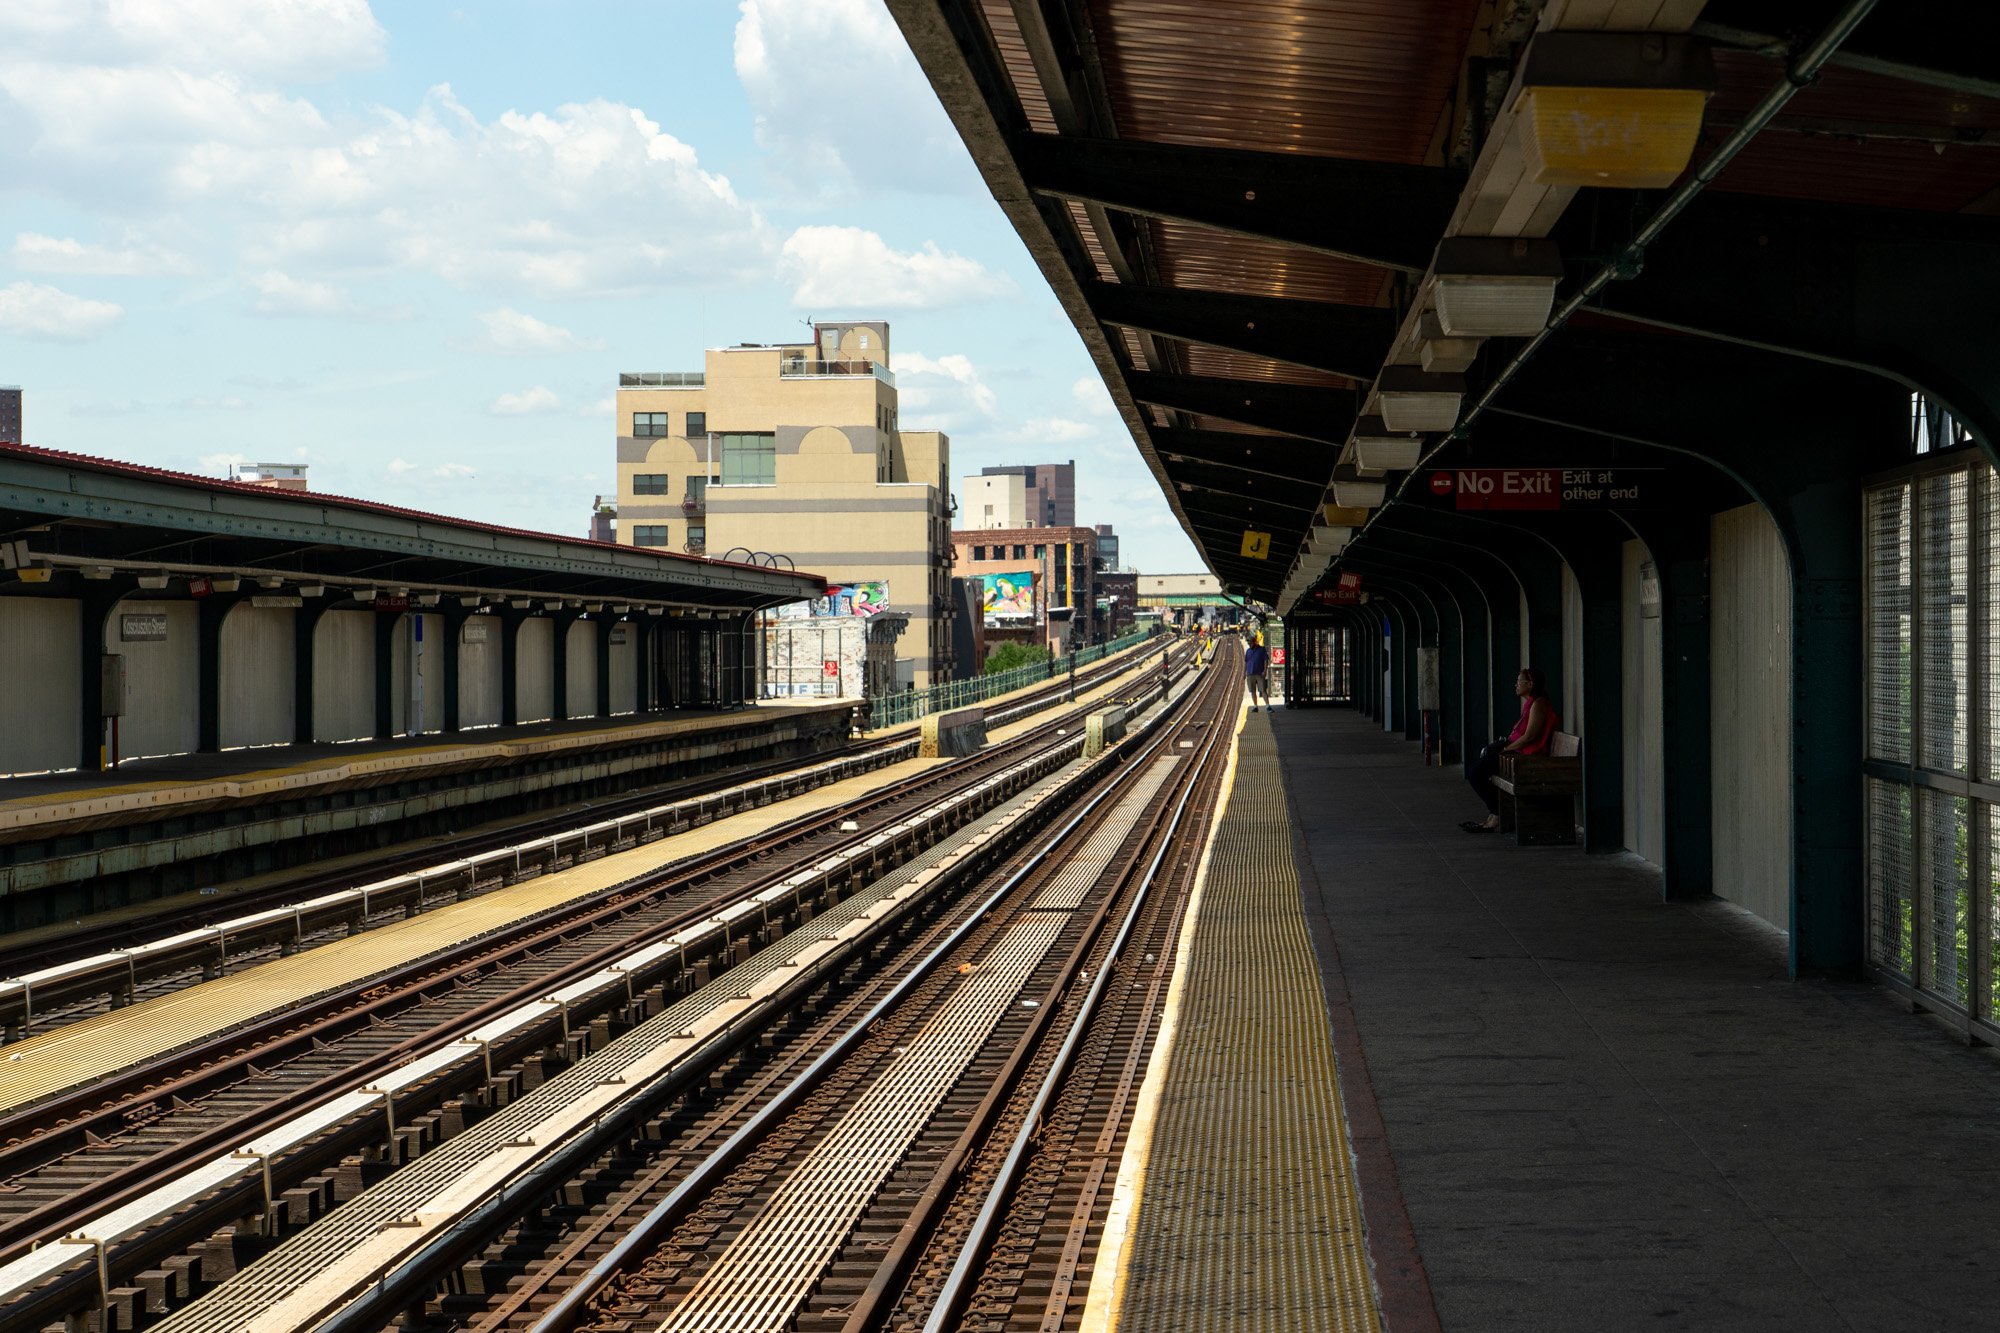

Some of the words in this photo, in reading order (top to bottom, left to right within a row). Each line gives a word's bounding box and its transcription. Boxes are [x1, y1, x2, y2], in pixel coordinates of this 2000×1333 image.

[1458, 472, 1495, 494] No
[1503, 472, 1552, 494] Exit
[1562, 471, 1592, 484] Exit
[1598, 471, 1613, 484] at
[1562, 487, 1604, 500] other
[1609, 486, 1639, 499] end
[1250, 538, 1261, 552] J
[1324, 590, 1337, 598] No
[1338, 590, 1355, 599] Exit
[376, 597, 389, 606] No
[390, 597, 407, 606] Exit
